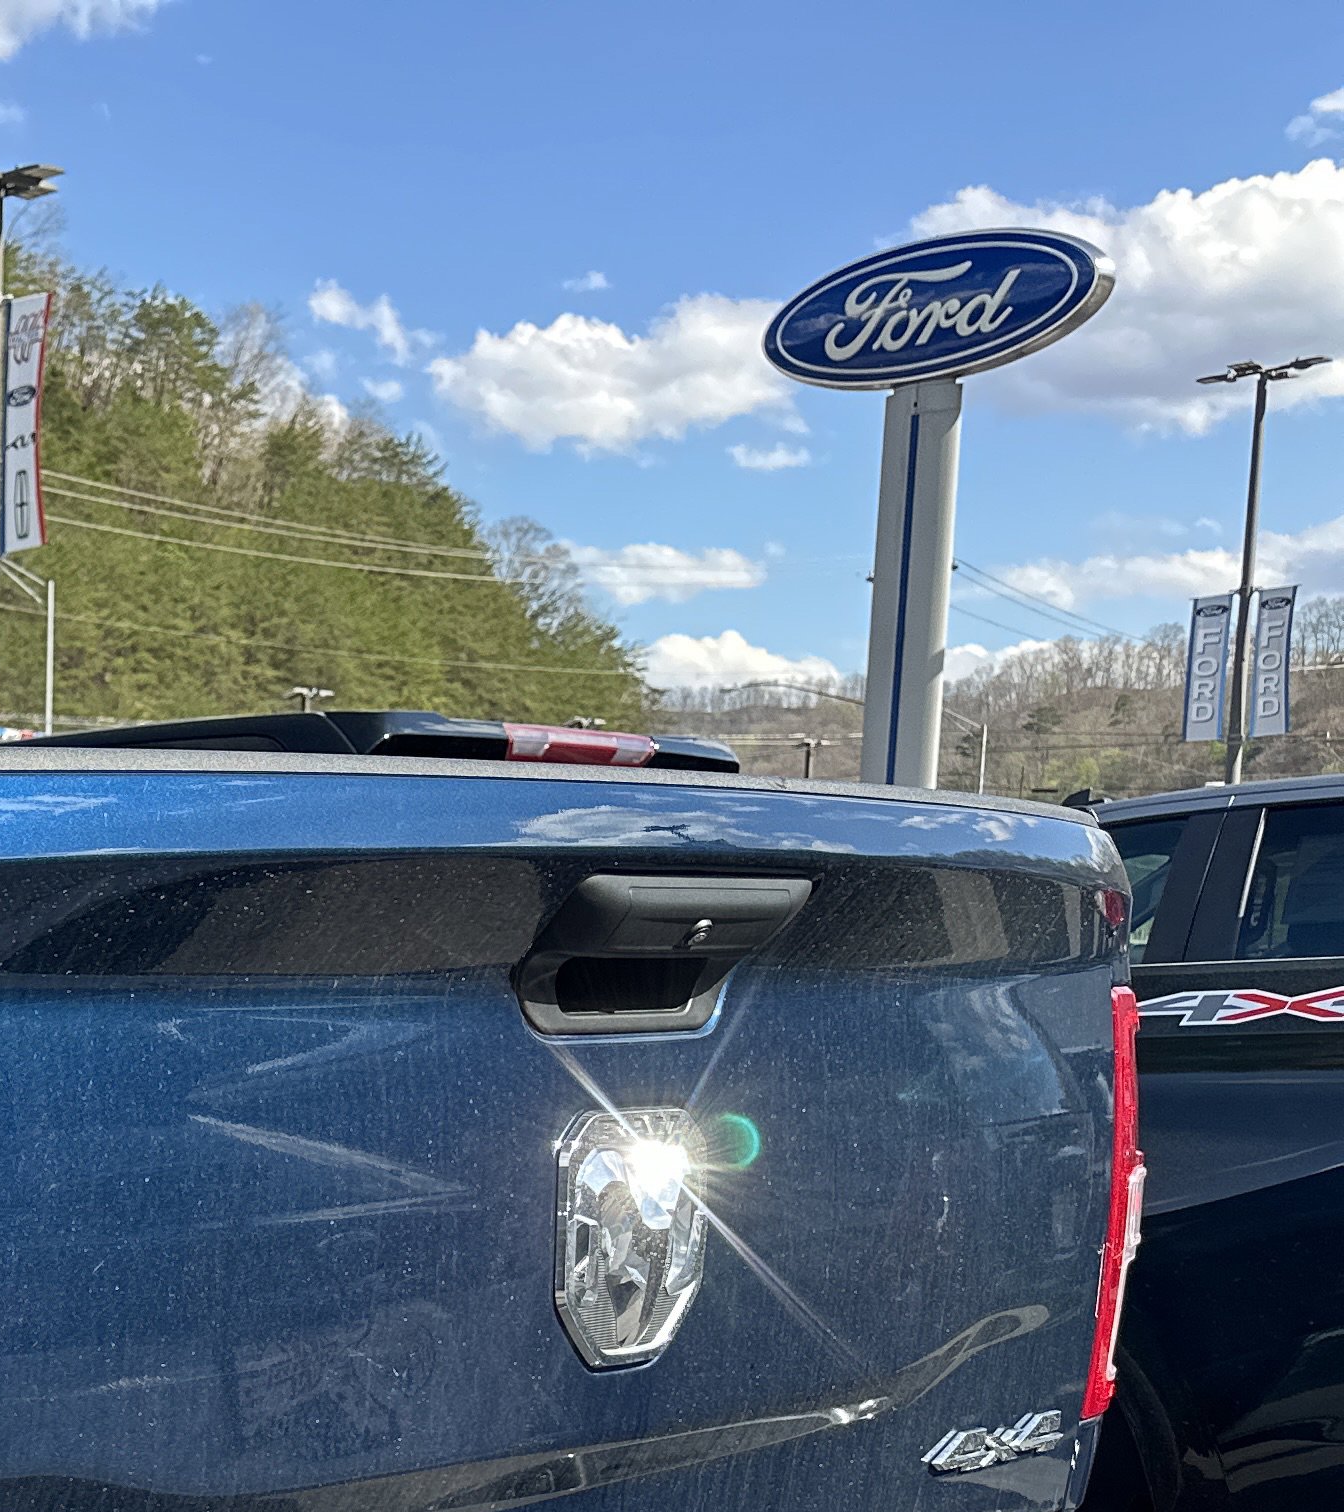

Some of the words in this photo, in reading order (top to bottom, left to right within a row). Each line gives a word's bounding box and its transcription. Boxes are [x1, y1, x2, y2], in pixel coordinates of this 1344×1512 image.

[824, 260, 1021, 362] Ford
[1191, 627, 1223, 723] FORD
[1257, 620, 1286, 719] FORD
